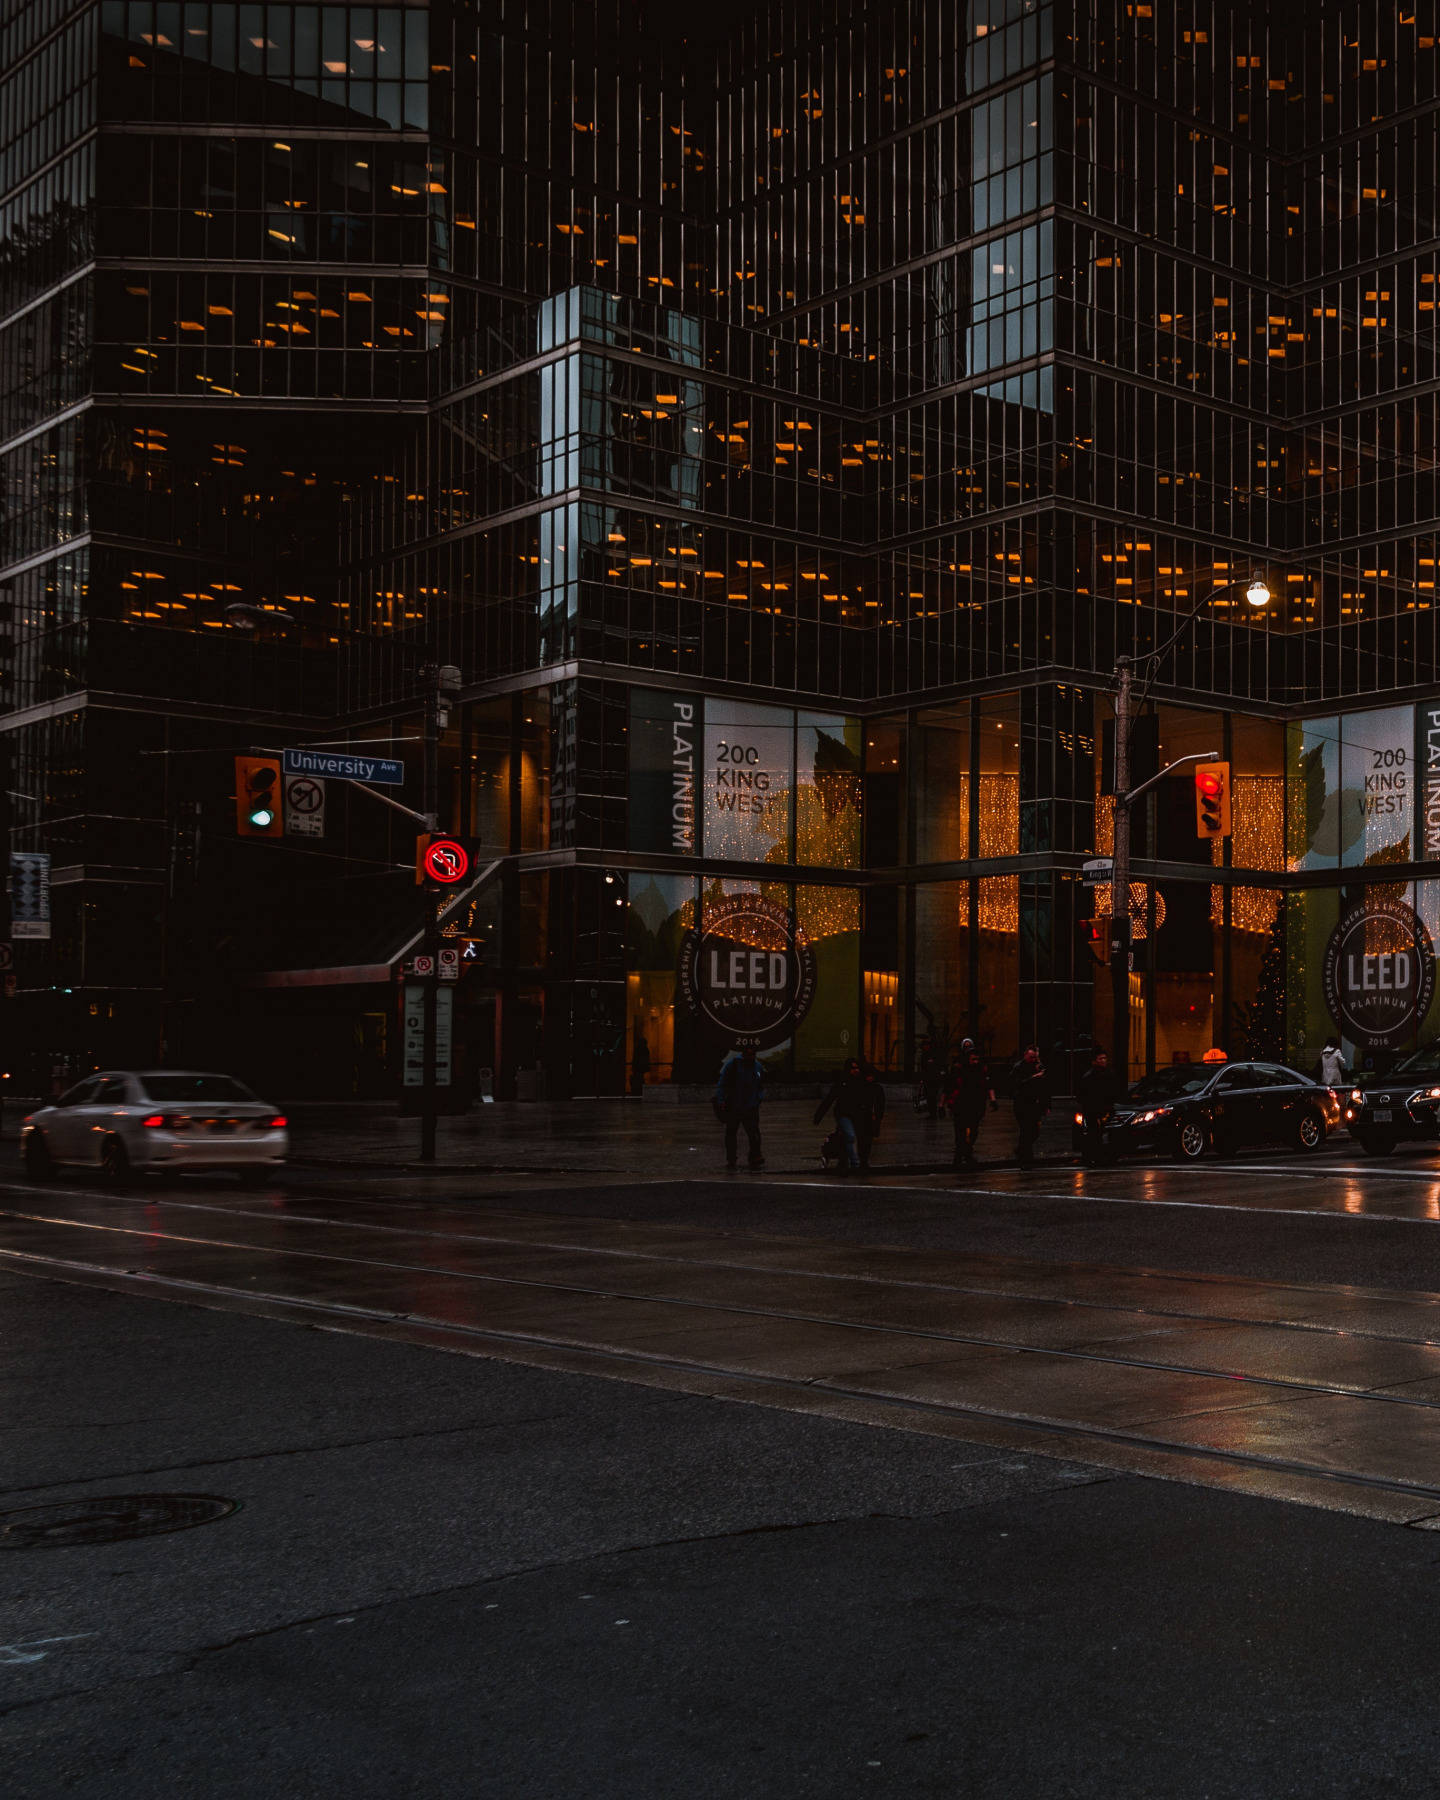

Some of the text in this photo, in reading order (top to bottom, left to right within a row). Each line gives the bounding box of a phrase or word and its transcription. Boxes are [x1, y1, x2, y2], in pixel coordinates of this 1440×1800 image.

[290, 751, 397, 779] University Ave
[716, 743, 759, 766] 200
[1373, 748, 1406, 769] 200
[671, 702, 694, 848] PLATINUM
[716, 767, 770, 791] KING
[1364, 771, 1406, 792] KING
[716, 791, 777, 815] WEST
[1358, 794, 1407, 816] WEST
[710, 950, 787, 990] LEED
[1348, 952, 1410, 991] LEED
[713, 994, 783, 1011] PLATINUM
[1350, 996, 1407, 1011] PLATINUM
[735, 1037, 761, 1046] 2016
[1368, 1037, 1389, 1046] 2016
